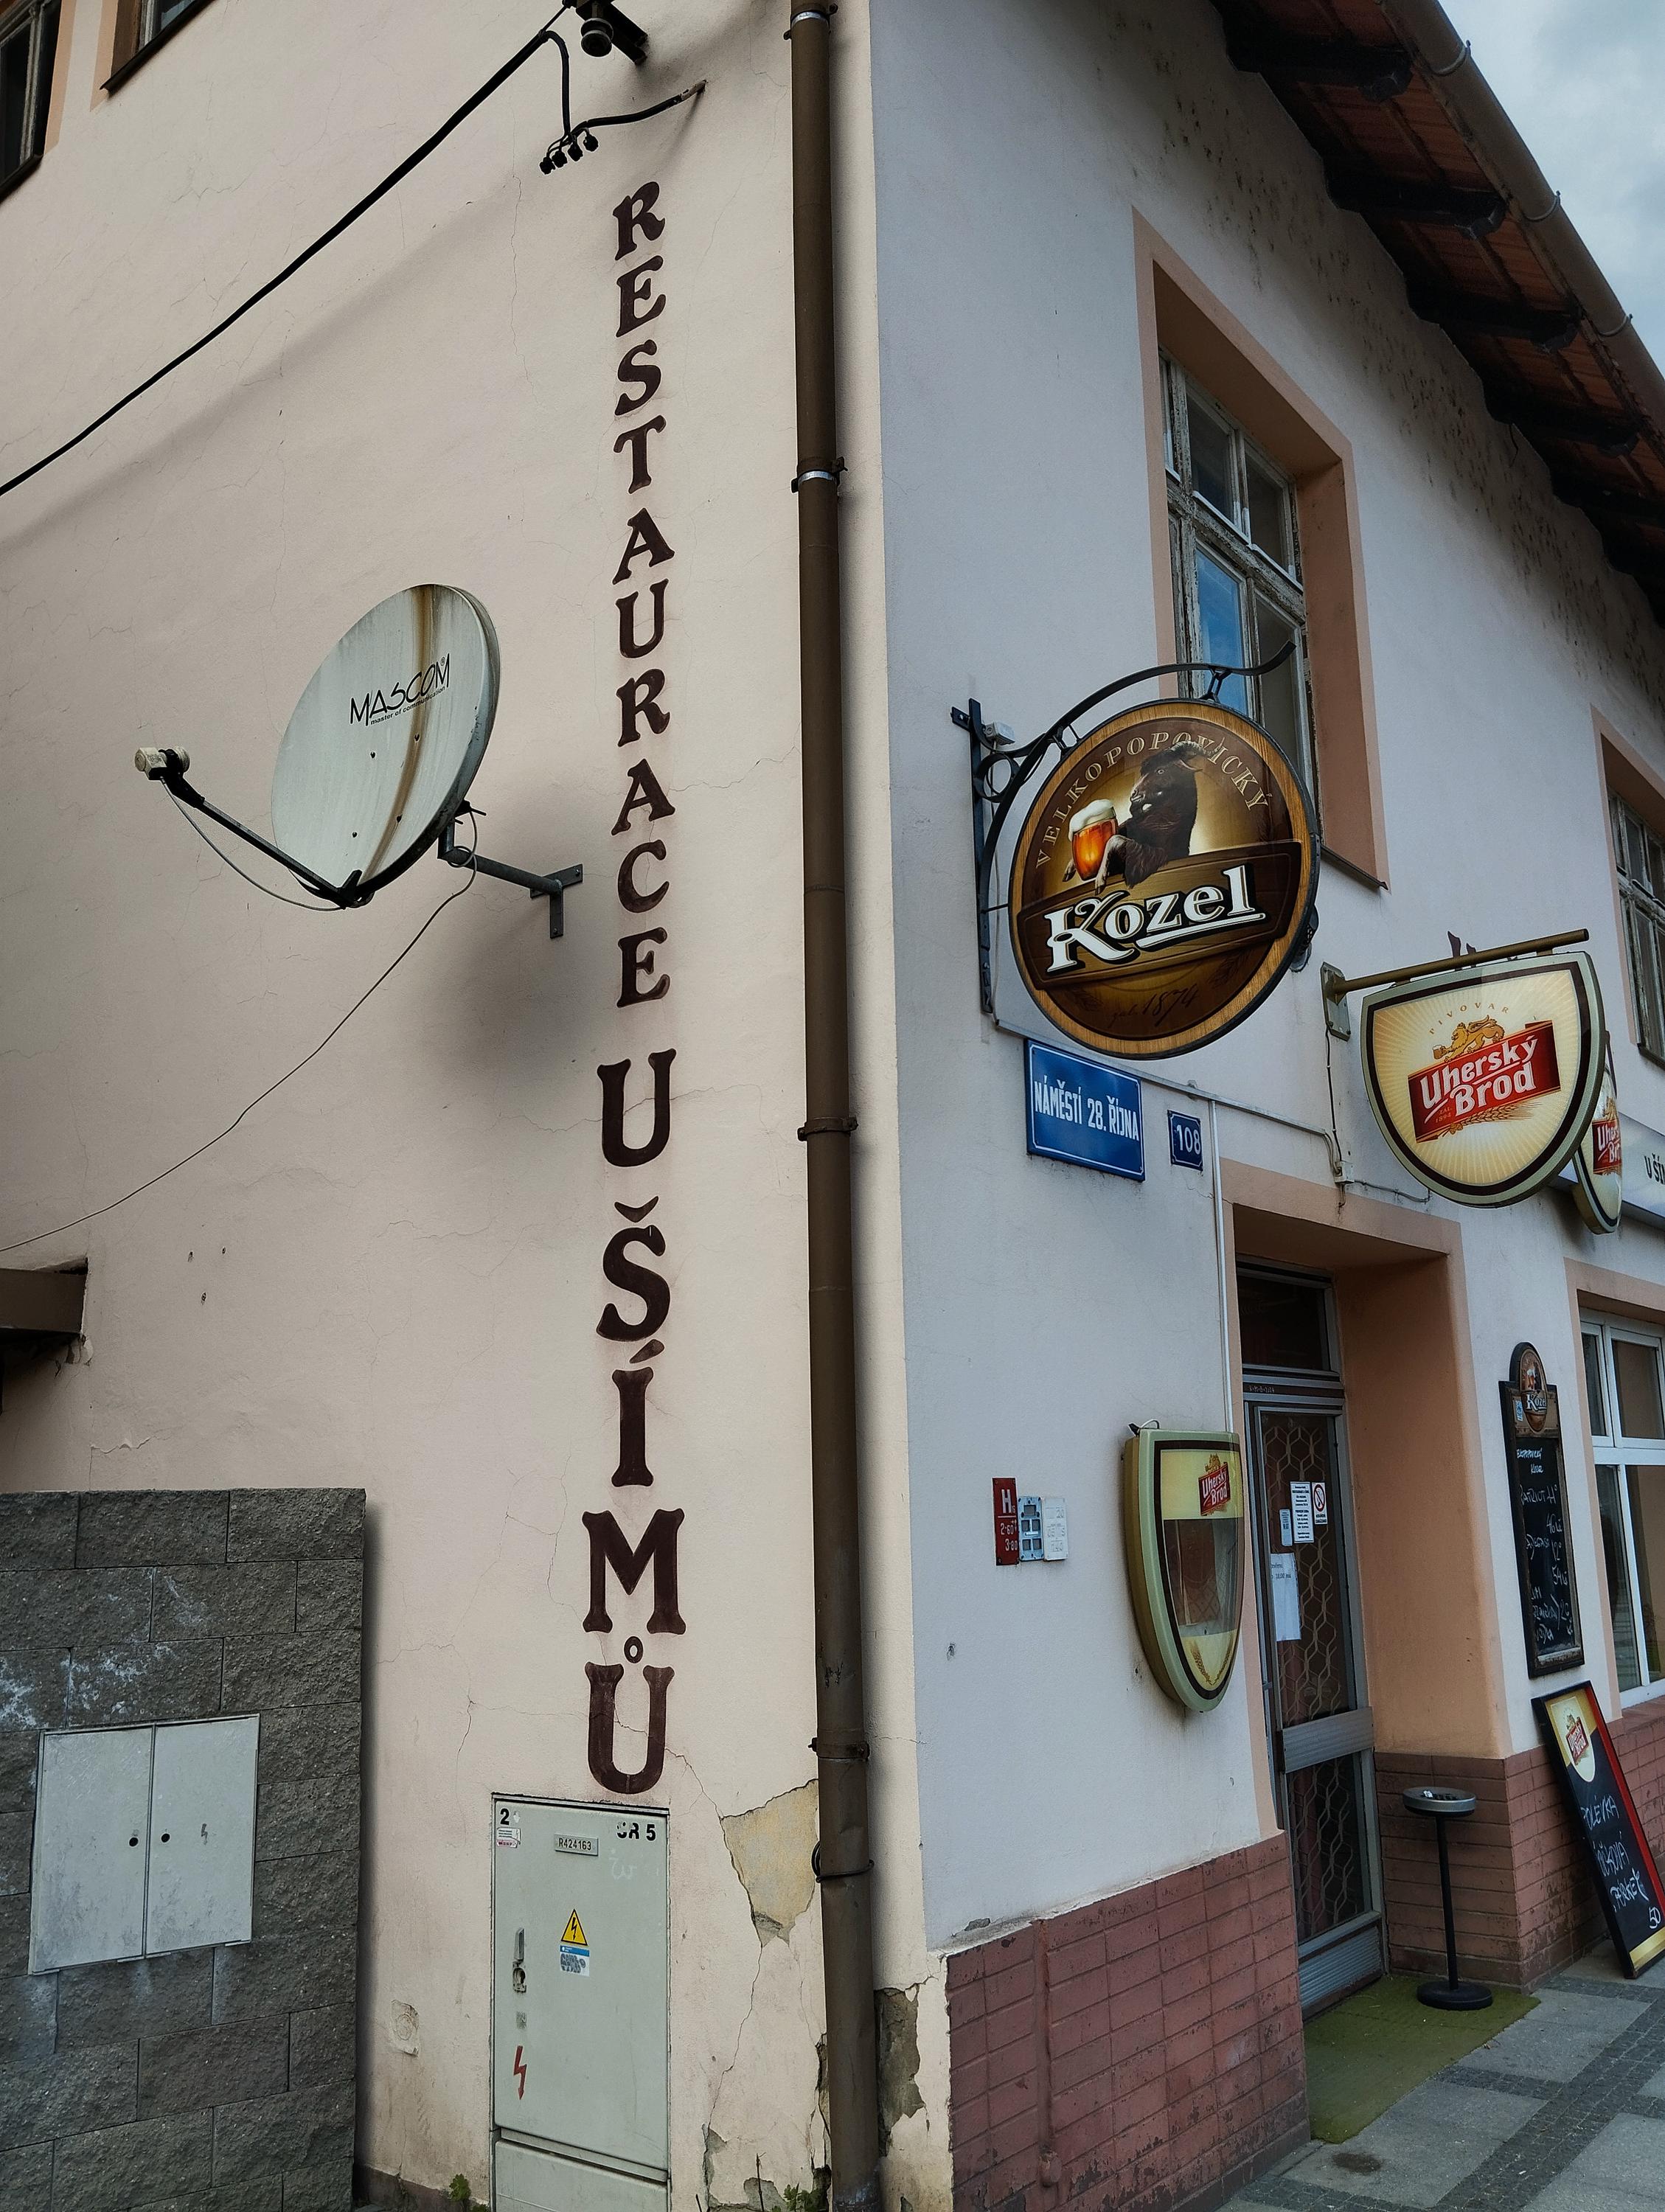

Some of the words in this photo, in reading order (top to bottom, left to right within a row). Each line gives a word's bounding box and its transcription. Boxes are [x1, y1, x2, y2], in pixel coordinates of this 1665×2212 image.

[611, 181, 676, 1008] RESTAURACE
[350, 653, 451, 726] MASCOM
[370, 713, 393, 726] master
[394, 709, 402, 717] of
[403, 686, 445, 713] communication
[1044, 863, 1267, 973] Kozel
[1143, 983, 1200, 1027] 1874
[1429, 1002, 1509, 1035] PIVOVAR
[1419, 1034, 1538, 1109] Uherský
[1450, 1060, 1537, 1117] Brod
[597, 1048, 677, 1168] U
[1035, 1075, 1082, 1125] NÁMĚSTÍ
[1087, 1098, 1107, 1132] 28.
[1107, 1095, 1139, 1141] ŘÍJNA
[1176, 1124, 1201, 1155] 108
[1644, 1155, 1652, 1179] U
[581, 1195, 686, 1795] ŠÍMŮ
[1211, 1482, 1228, 1505] Brod
[500, 1808, 510, 1826] 2
[646, 1823, 657, 1841] 5
[558, 1837, 592, 1851] R424163
